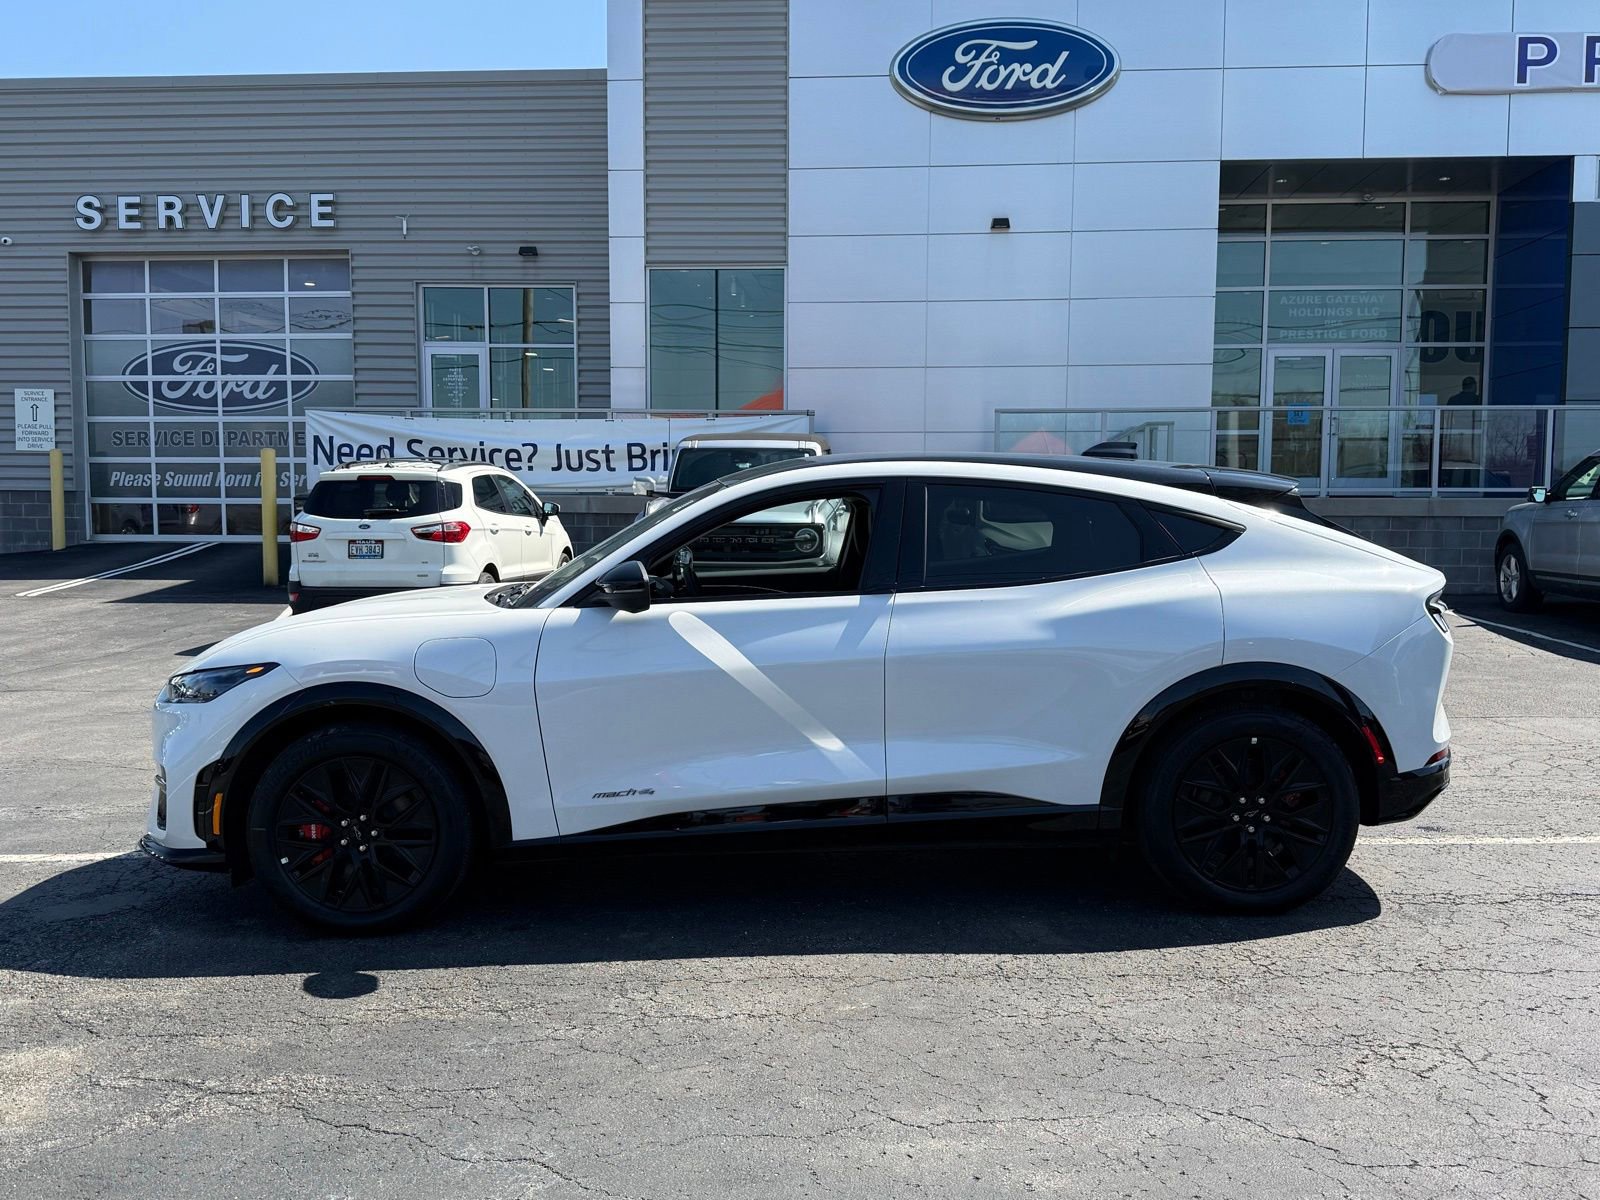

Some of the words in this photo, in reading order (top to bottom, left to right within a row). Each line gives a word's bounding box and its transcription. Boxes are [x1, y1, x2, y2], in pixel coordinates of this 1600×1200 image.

[942, 39, 1070, 92] Ford
[75, 191, 336, 231] SERVICE
[1280, 295, 1321, 305] AZURE
[1326, 294, 1385, 304] GATEWAY
[1288, 307, 1353, 317] HOLDINGS
[1357, 306, 1380, 316] LLC
[1280, 328, 1347, 339] PRESTIGE
[1351, 328, 1388, 339] FORD
[161, 351, 280, 400] Ford
[112, 431, 195, 447] SERVICE
[313, 435, 395, 466] Need
[406, 438, 538, 472] Service?
[551, 443, 617, 472] Just
[626, 442, 676, 472] Bri
[110, 472, 161, 487] Please
[164, 472, 213, 487] Sound
